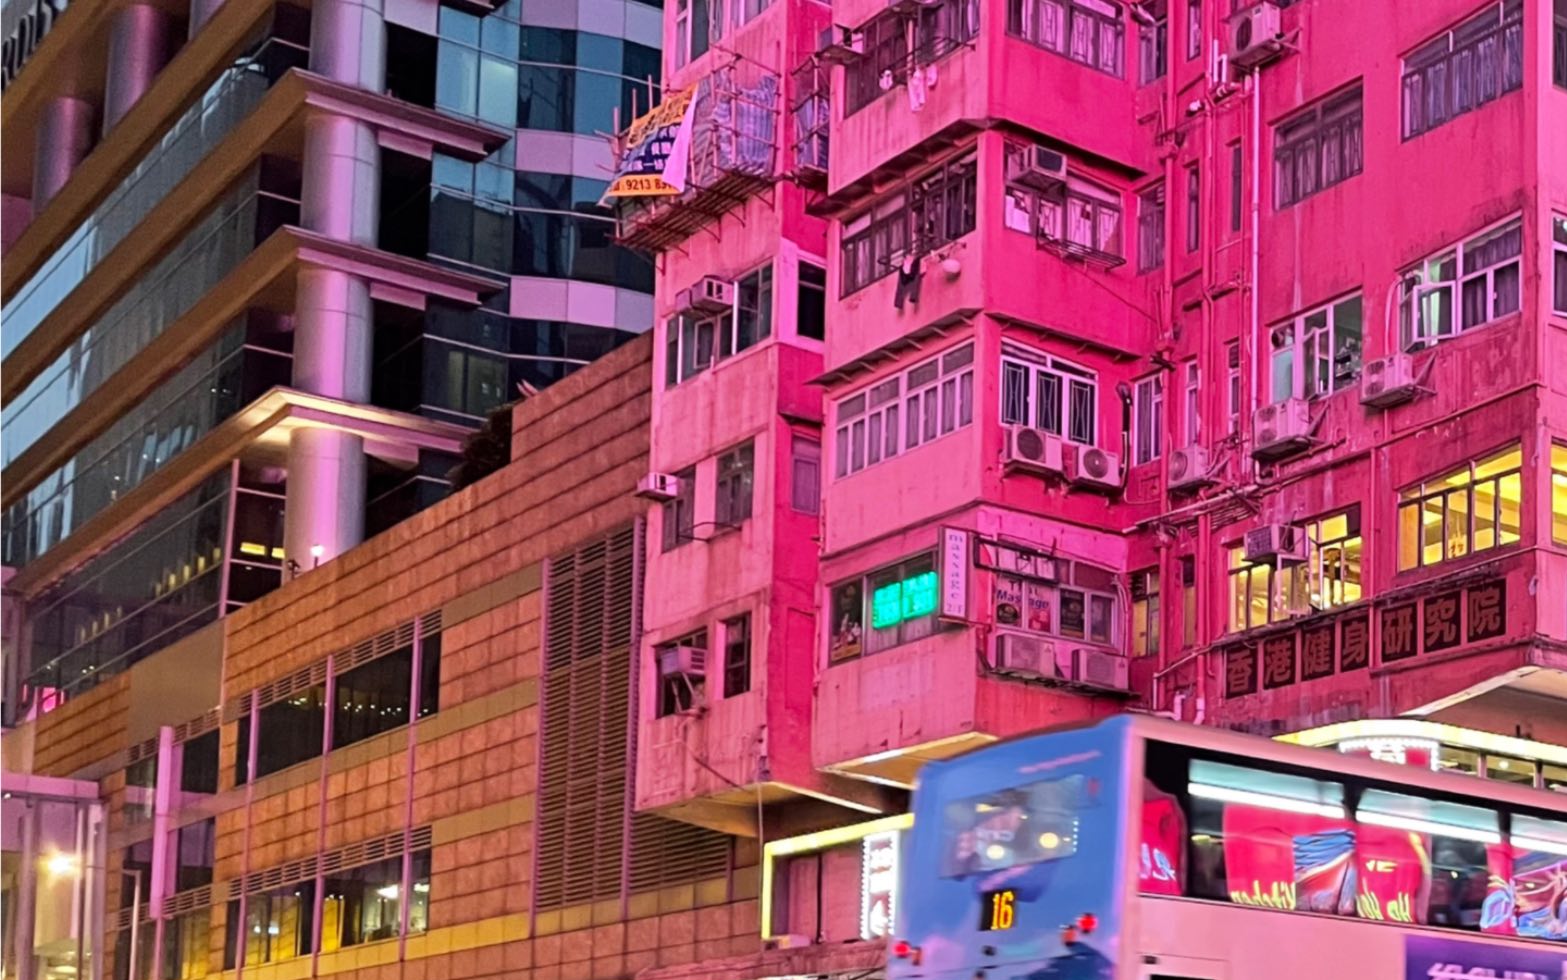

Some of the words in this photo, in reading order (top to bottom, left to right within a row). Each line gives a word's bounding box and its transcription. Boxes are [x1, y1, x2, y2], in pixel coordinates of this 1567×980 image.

[1227, 587, 1501, 692] 香港健身研究院
[991, 890, 1015, 930] 16
